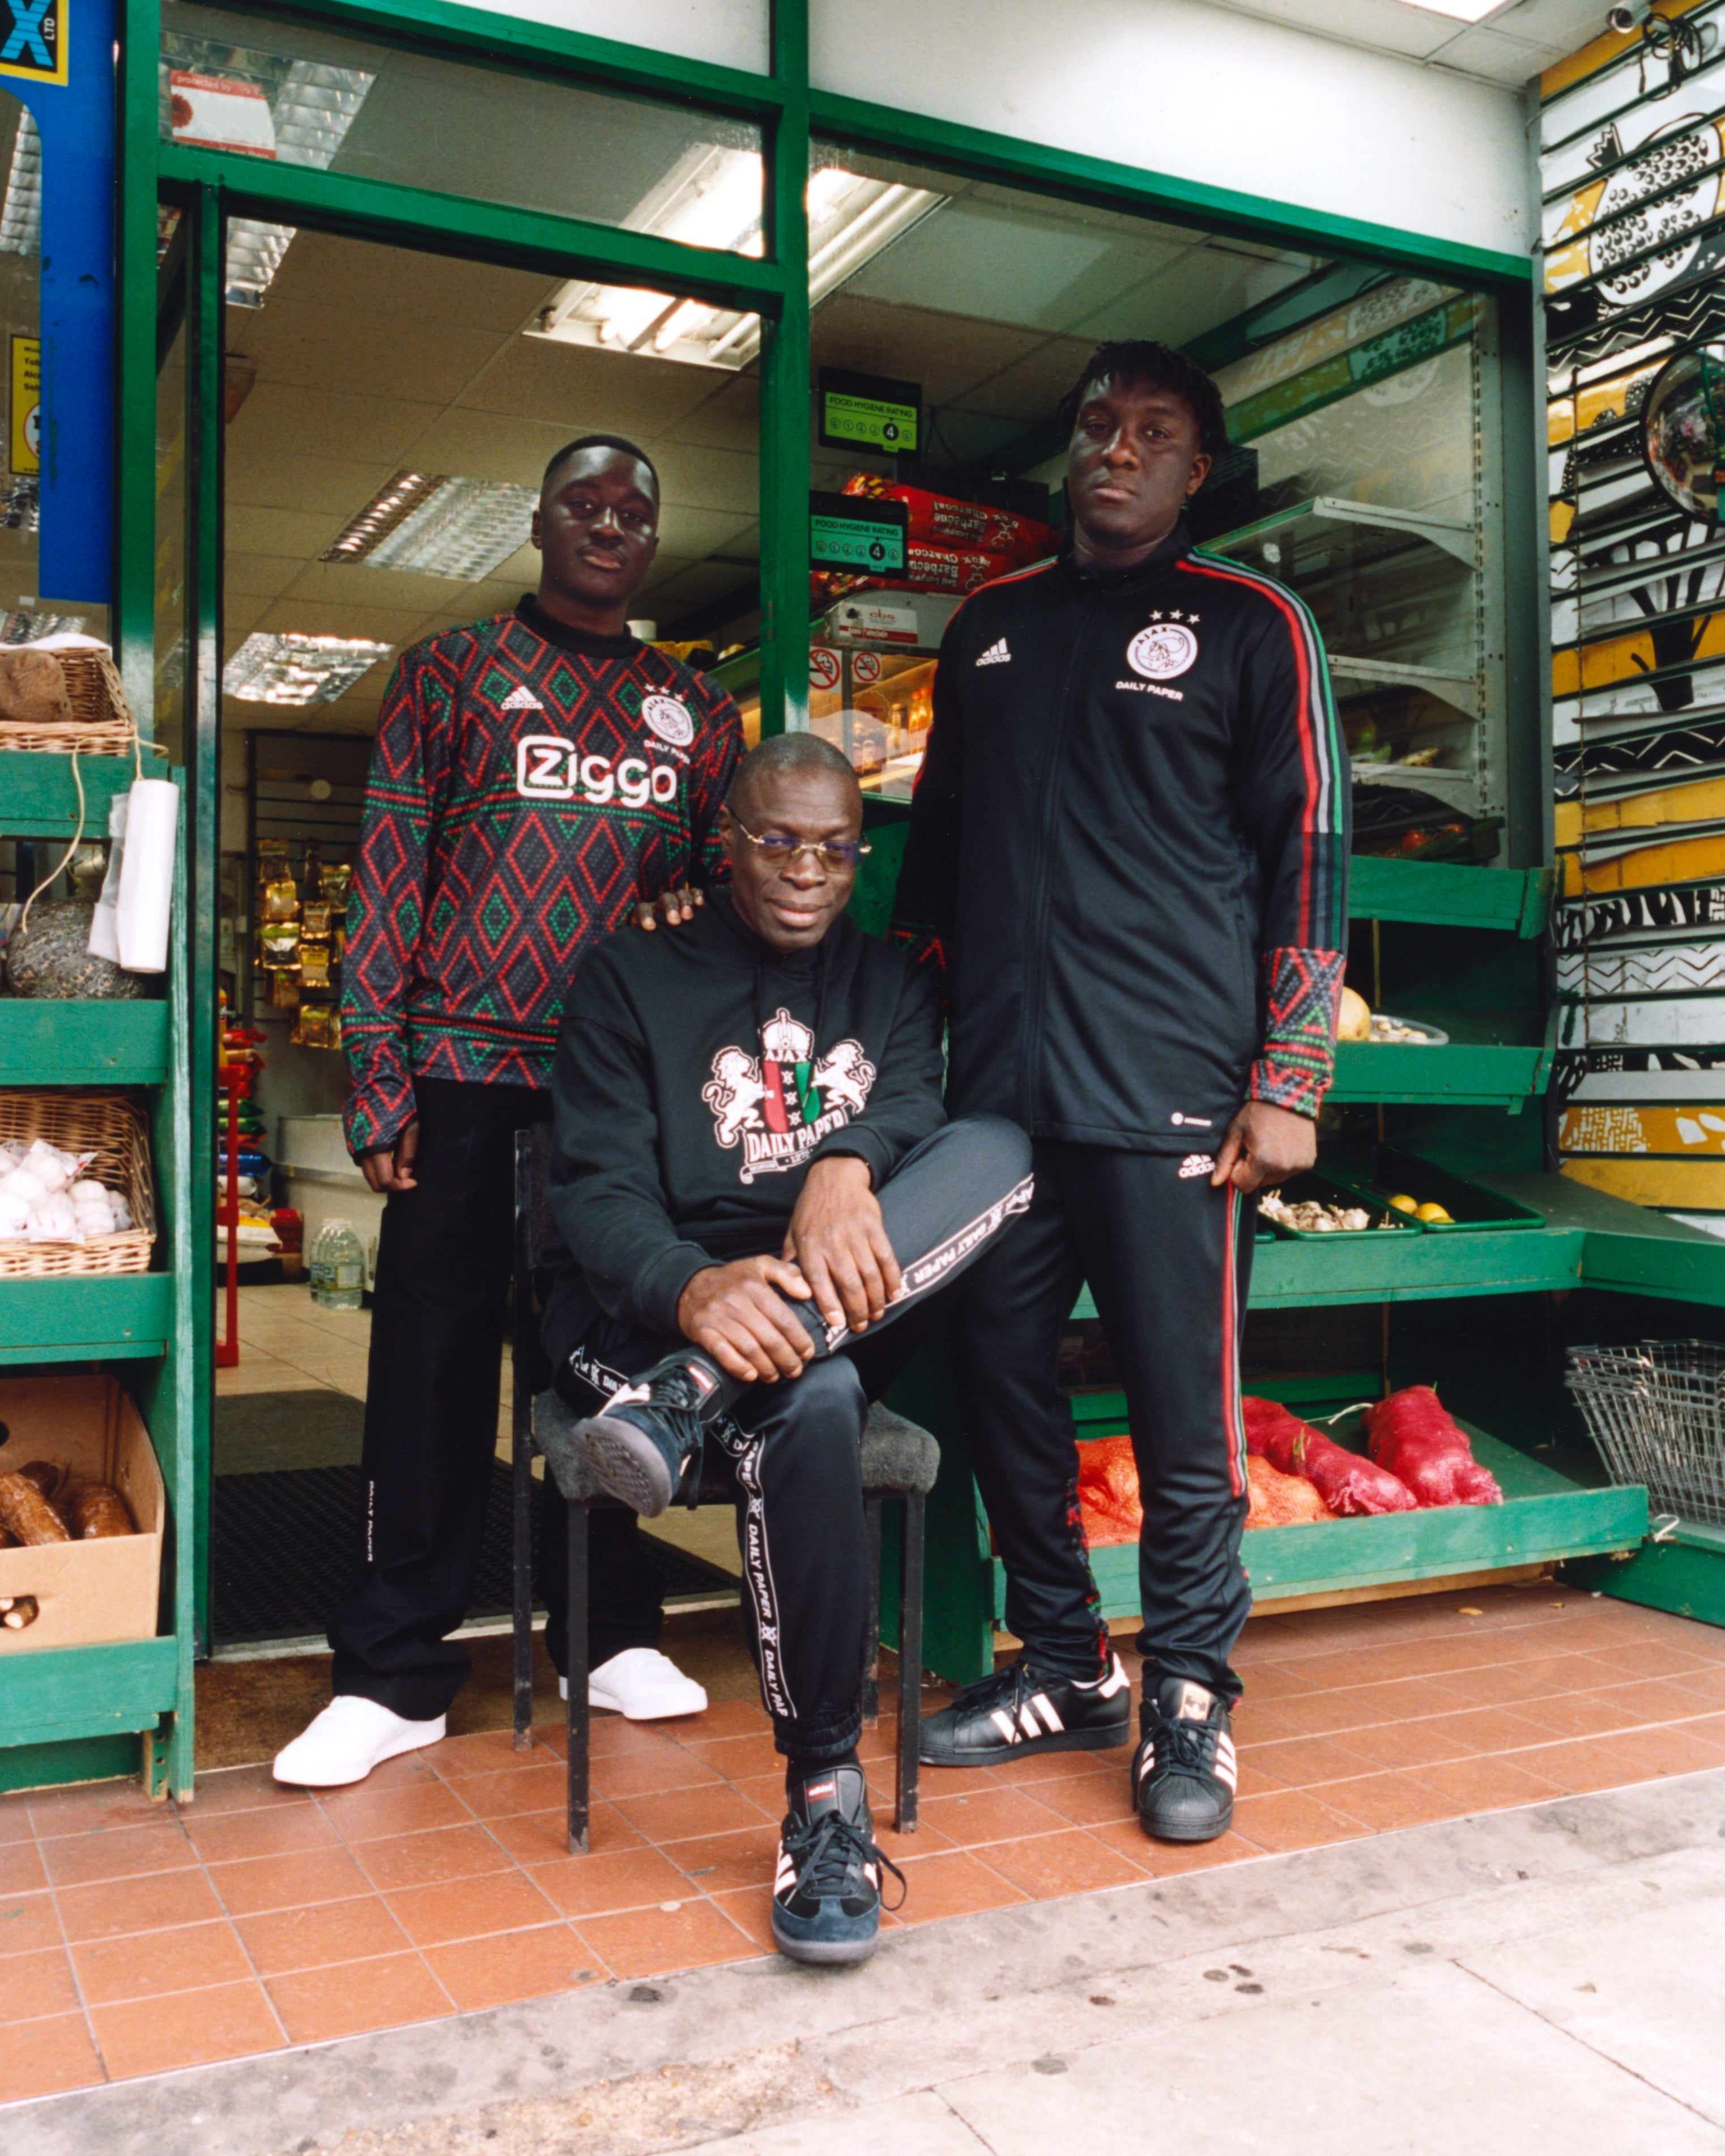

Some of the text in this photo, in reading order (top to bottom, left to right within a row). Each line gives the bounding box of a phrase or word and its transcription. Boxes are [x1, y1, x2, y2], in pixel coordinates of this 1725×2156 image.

[44, 17, 55, 41] LTD
[177, 76, 219, 89] protected
[221, 81, 231, 92] by
[830, 397, 913, 418] FOOD HYGIENE RATING
[887, 426, 895, 438] 4
[934, 501, 988, 520] Charcoal
[815, 519, 898, 537] FOOD HYGIENE RATING
[934, 513, 987, 533] Barbecue
[873, 546, 880, 558] 4
[1137, 627, 1168, 645] AJAX
[976, 653, 1011, 667] adidas
[1115, 681, 1183, 701] DAILY PAPER
[501, 700, 544, 710] adidas
[647, 699, 665, 711] AJAX
[644, 739, 670, 752] DAILY
[522, 741, 677, 809] Ziggo
[765, 1049, 807, 1062] AJAX
[748, 1132, 798, 1162] DAILY
[1179, 1162, 1215, 1178] adidas
[957, 1223, 987, 1255] DAILY
[913, 1248, 956, 1283] PAPER
[749, 1524, 762, 1570] DAILY
[753, 1572, 772, 1618] PAPER
[765, 1649, 780, 1692] DAILY
[772, 1693, 789, 1717] PAP
